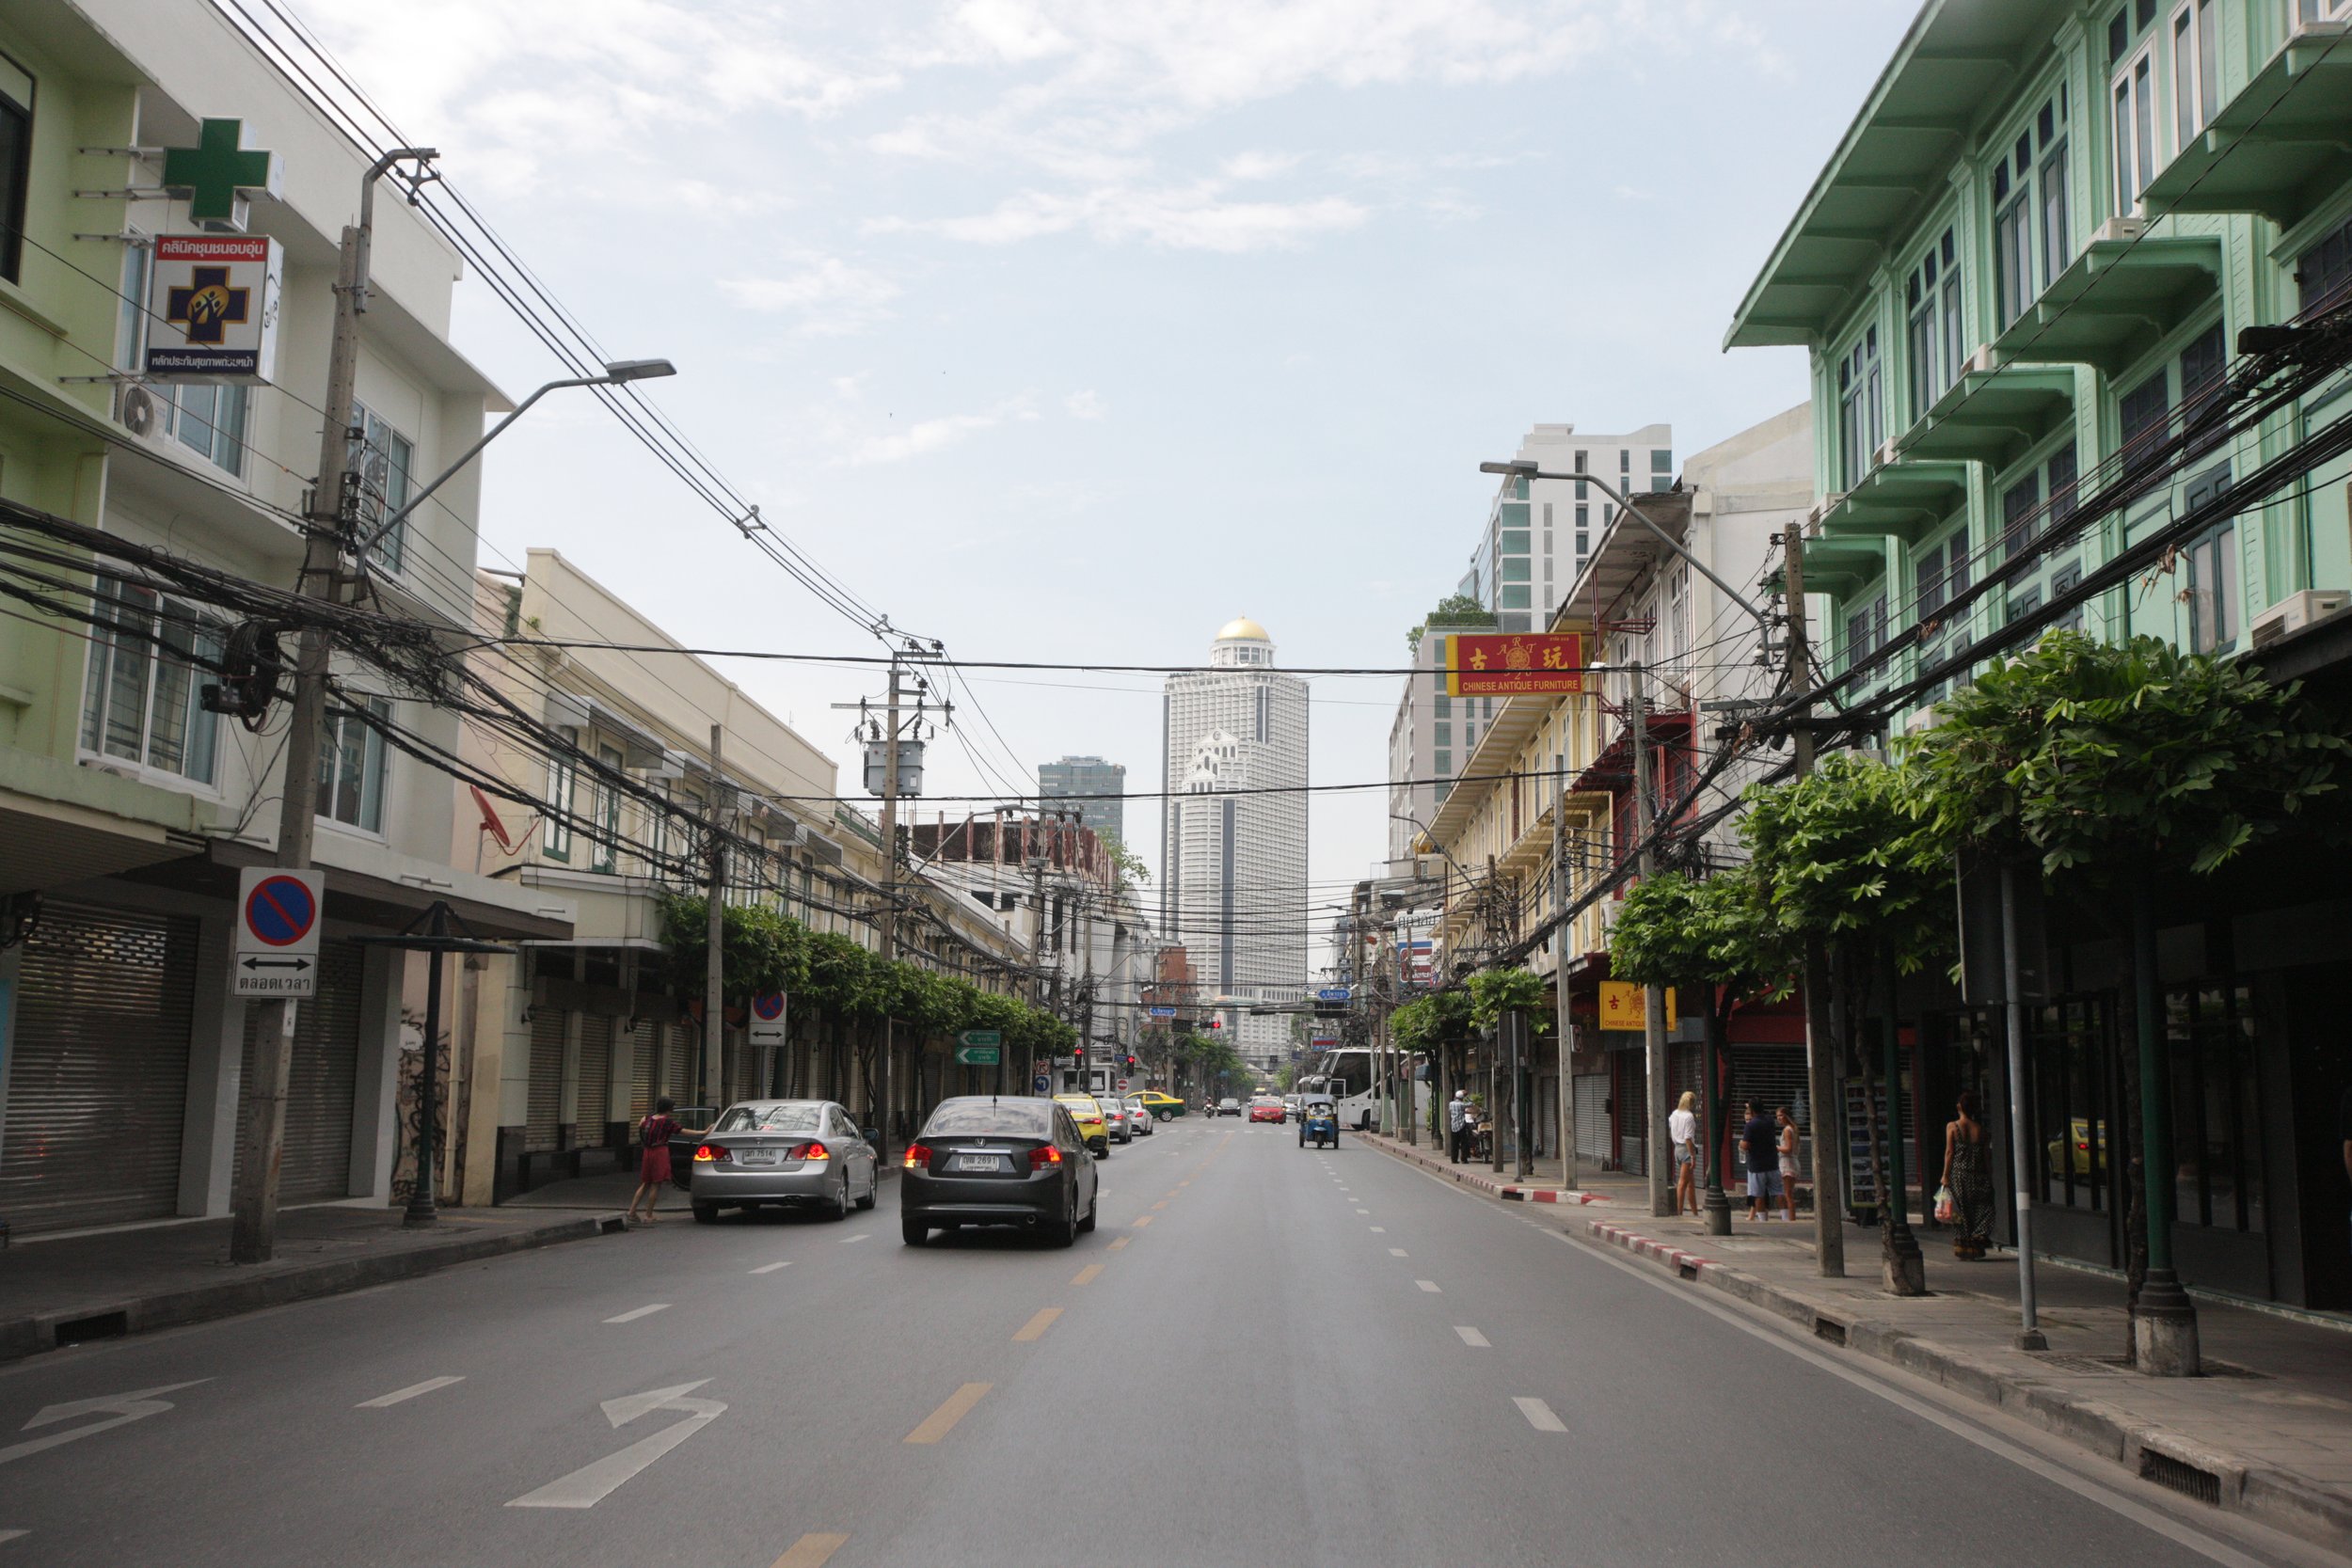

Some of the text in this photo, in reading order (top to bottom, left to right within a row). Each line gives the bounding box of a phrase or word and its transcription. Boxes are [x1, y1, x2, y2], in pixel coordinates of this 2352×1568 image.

[1543, 646, 1568, 670] 玩
[1463, 680, 1578, 691] CHINESE ANTIQUE FURNITURE
[240, 976, 310, 990] ตลอดเวลา
[1609, 994, 1620, 1010] 古
